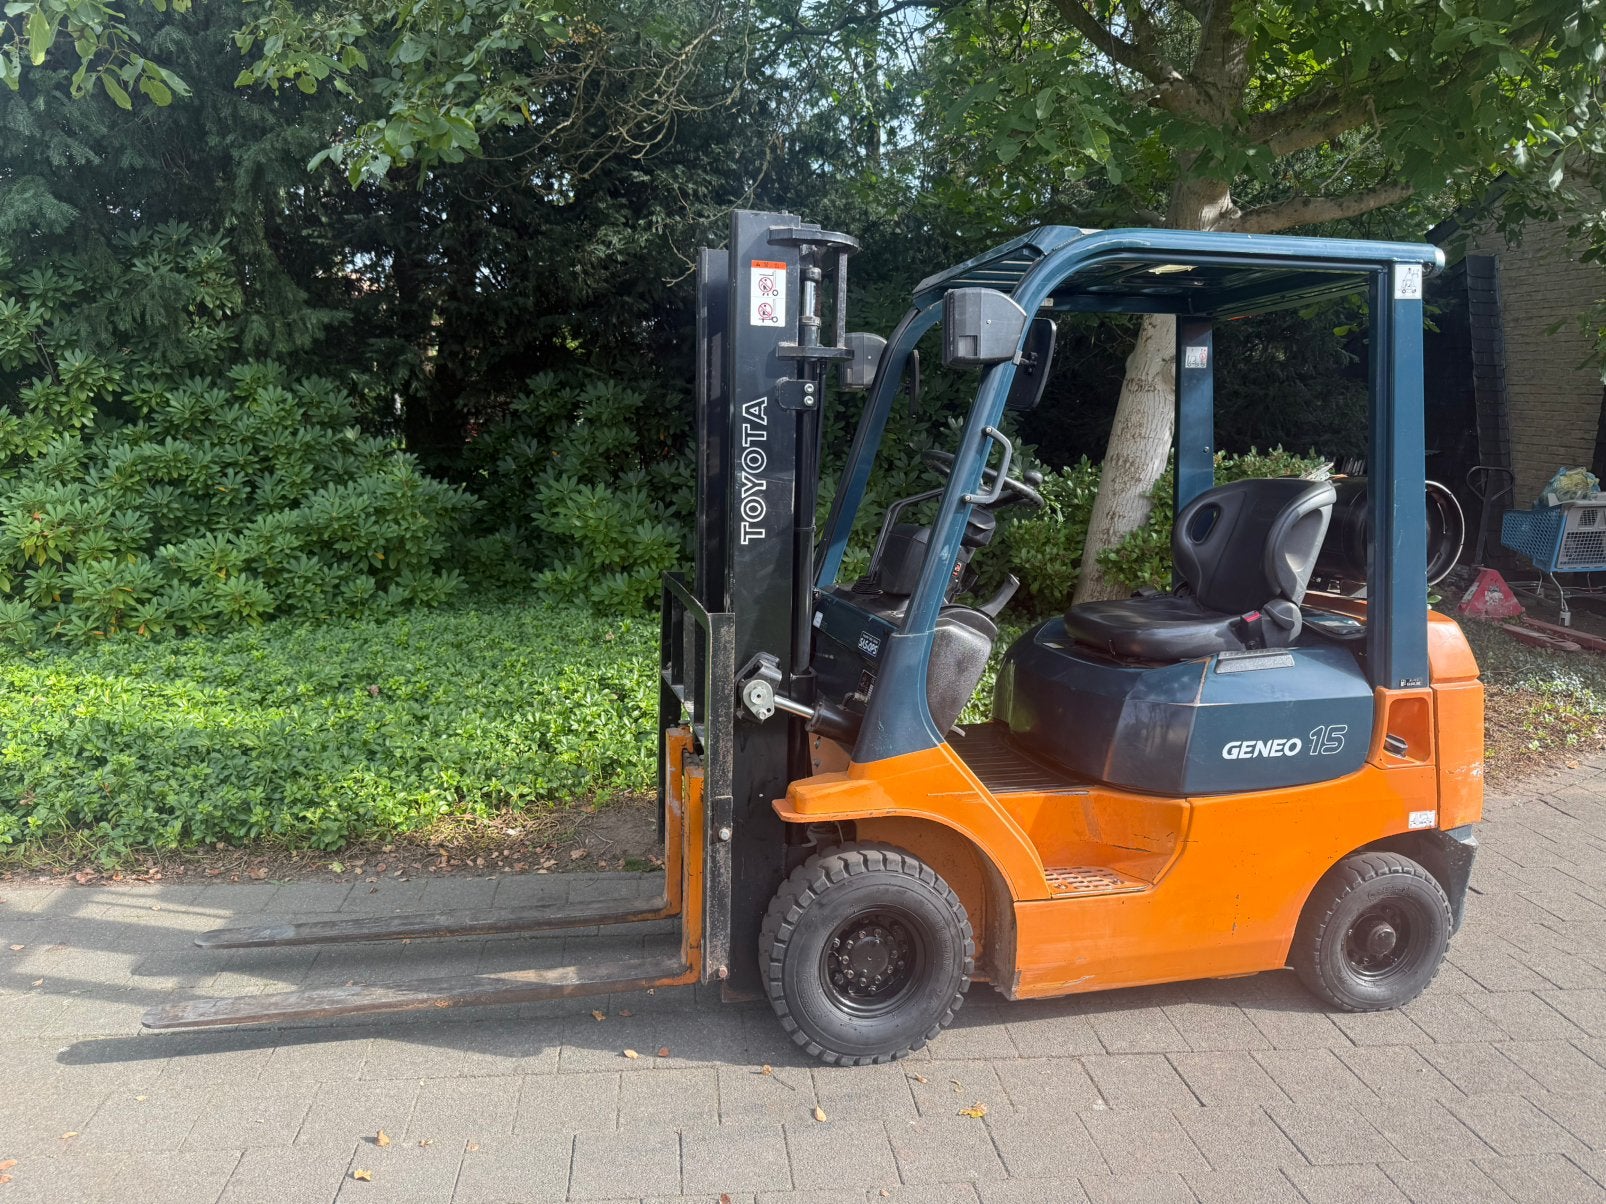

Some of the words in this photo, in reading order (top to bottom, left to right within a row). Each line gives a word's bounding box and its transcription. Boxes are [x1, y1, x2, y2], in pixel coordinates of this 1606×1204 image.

[740, 396, 767, 545] TOYOTA
[1222, 737, 1302, 760] GENEO
[1309, 724, 1348, 755] 15
